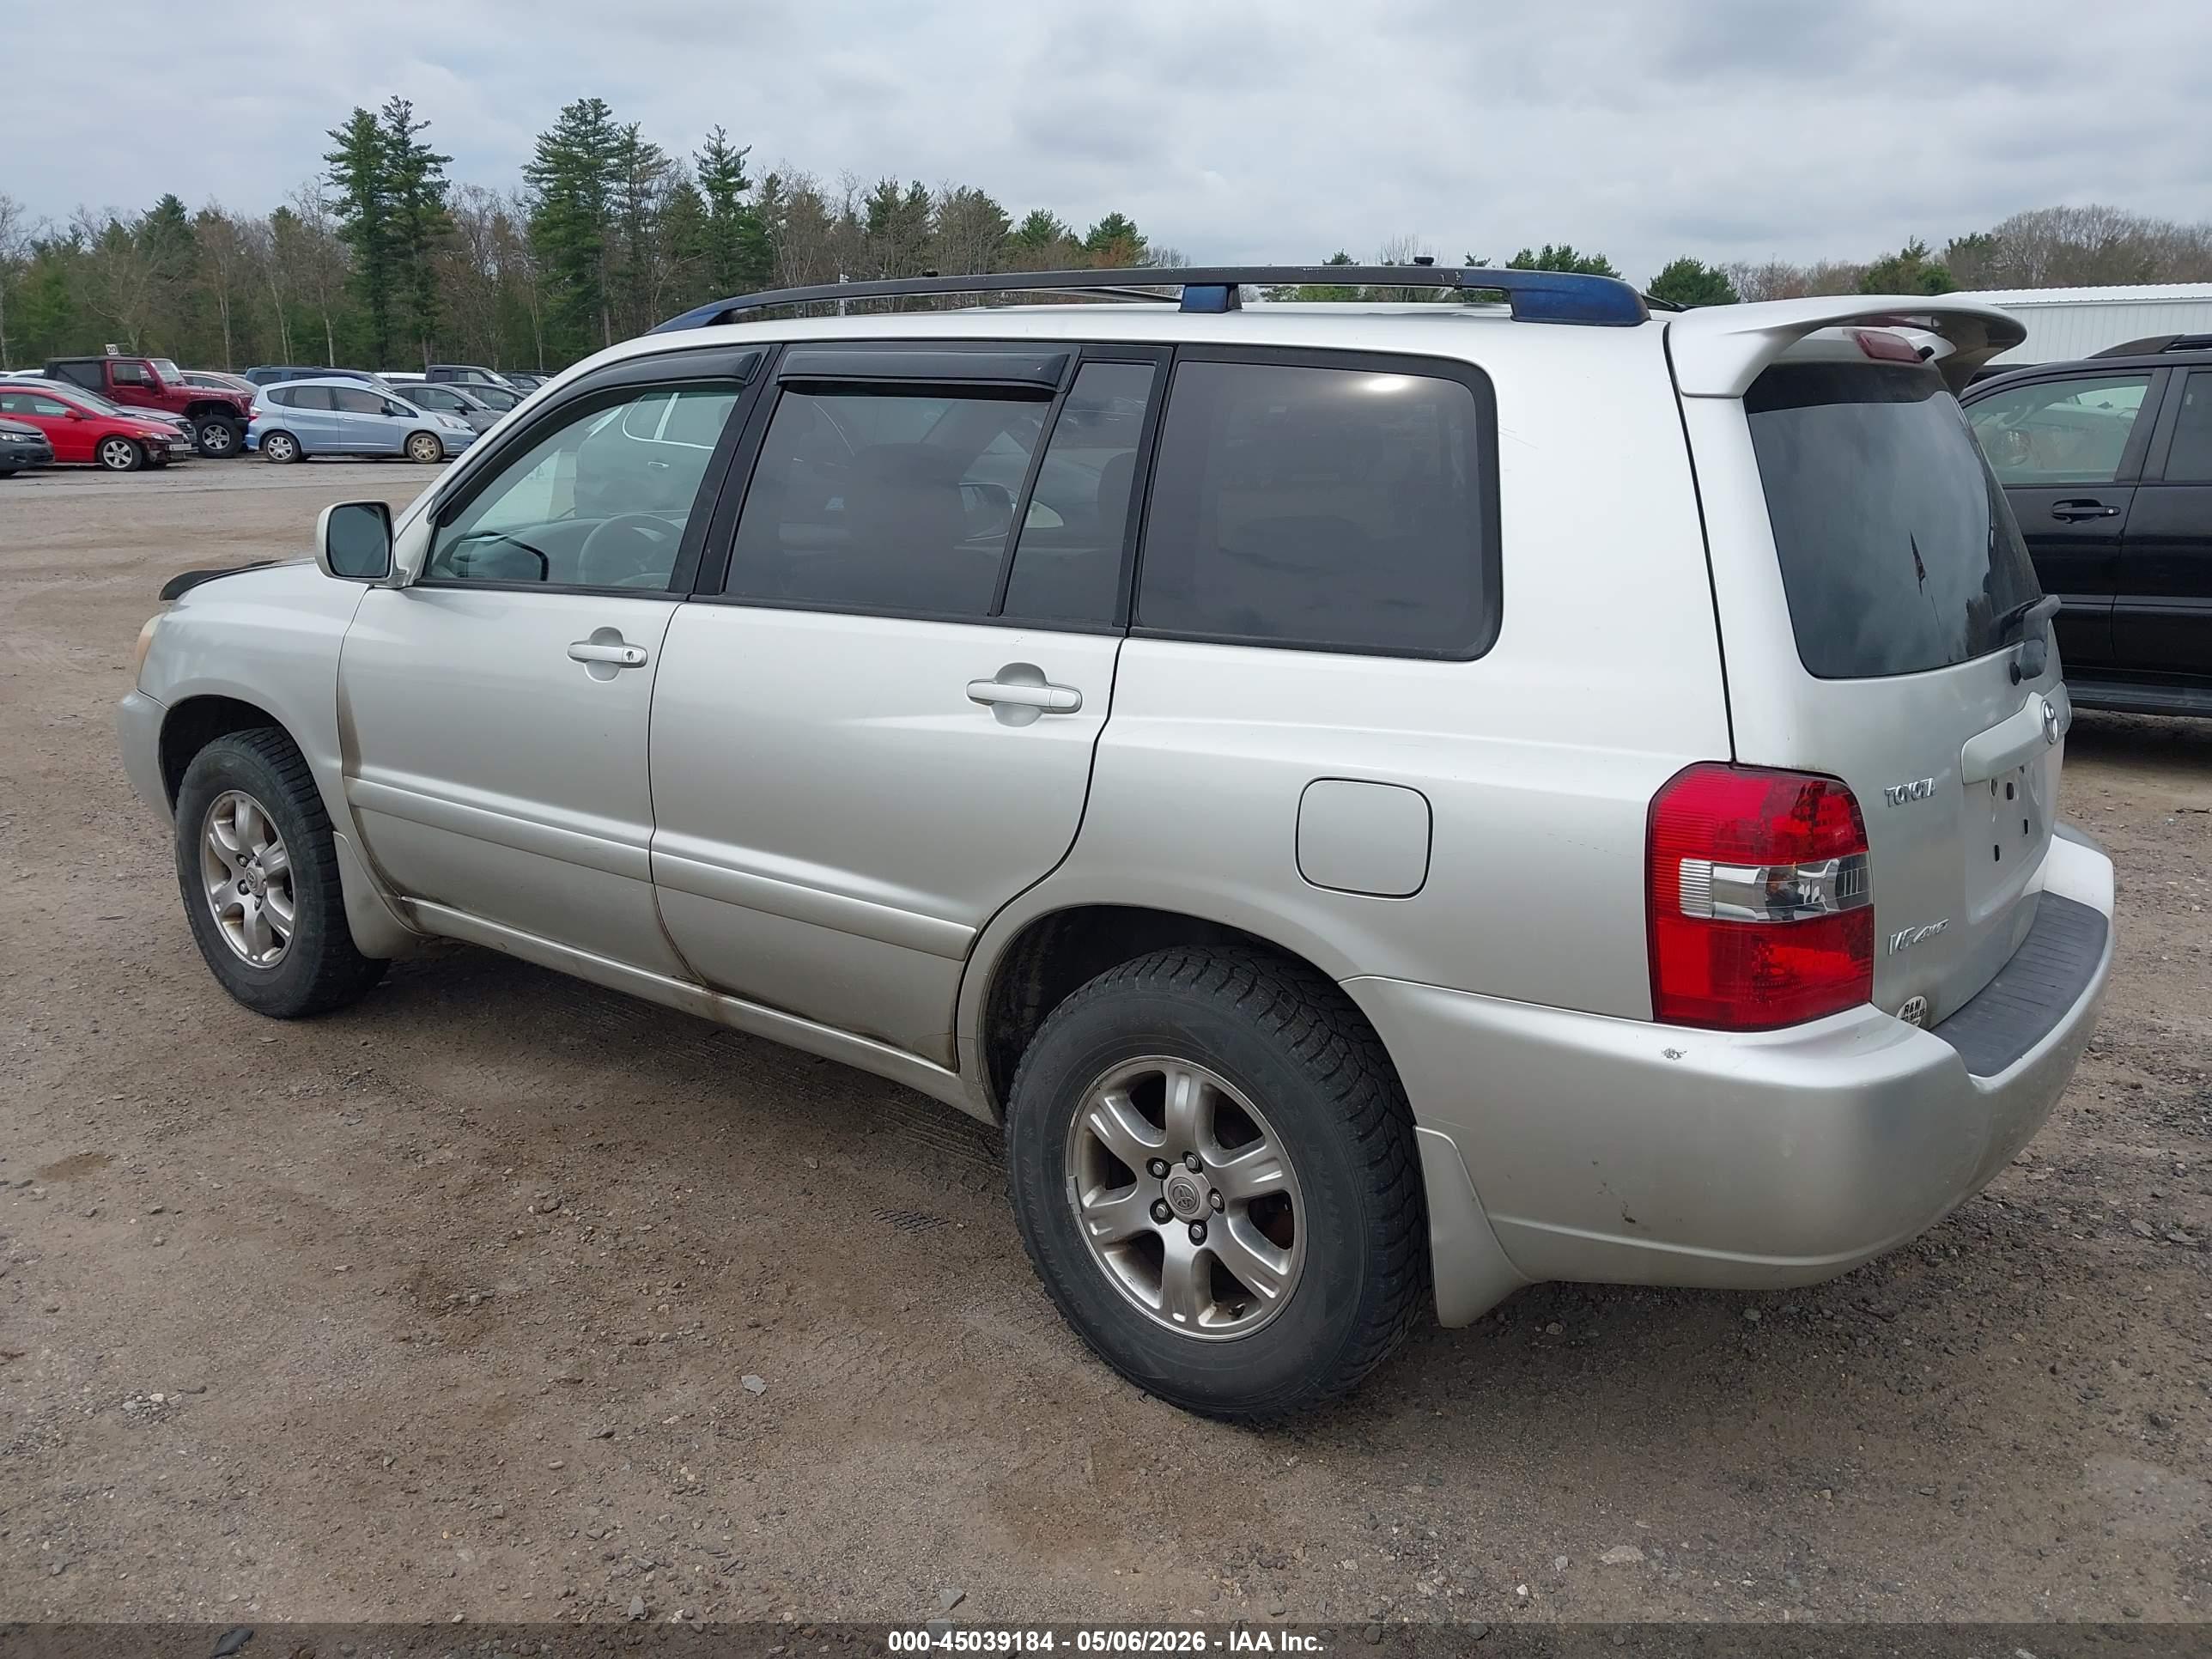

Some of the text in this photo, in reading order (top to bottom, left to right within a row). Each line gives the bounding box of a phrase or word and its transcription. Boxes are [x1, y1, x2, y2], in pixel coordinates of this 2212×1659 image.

[1884, 777, 1936, 808] TOYOTA
[1903, 998, 1922, 1016] R&M
[1910, 1008, 1925, 1019] SALES
